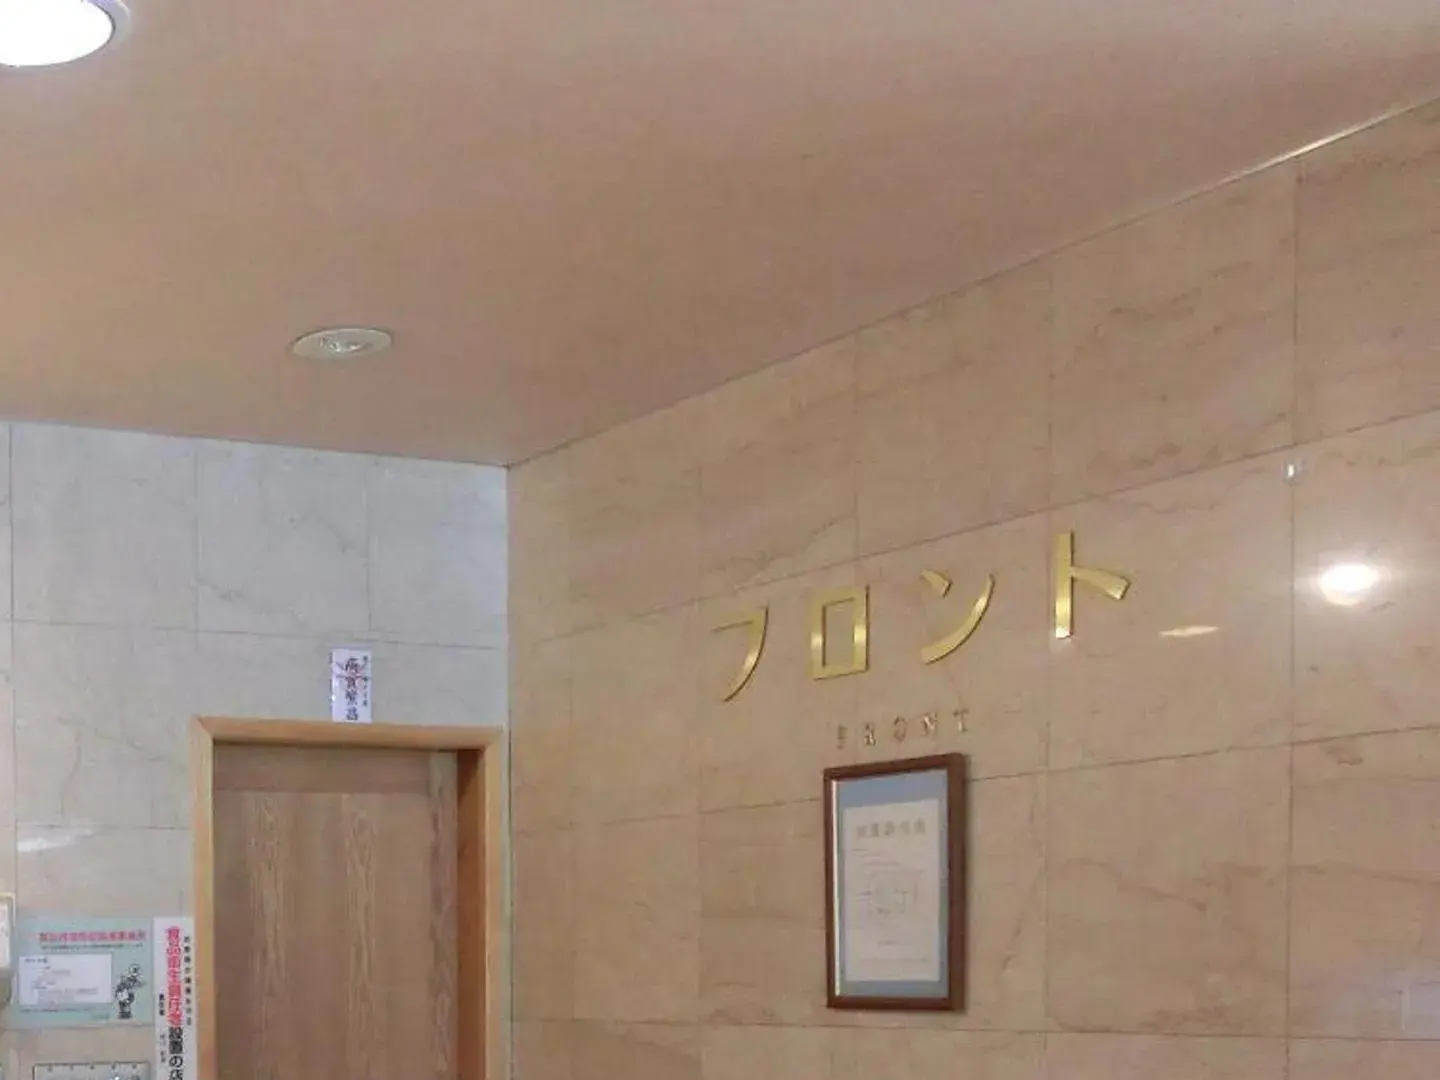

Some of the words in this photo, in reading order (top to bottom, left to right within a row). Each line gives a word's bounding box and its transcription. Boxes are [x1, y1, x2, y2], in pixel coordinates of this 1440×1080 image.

[711, 531, 1131, 703] フロント
[837, 708, 969, 750] FRONT
